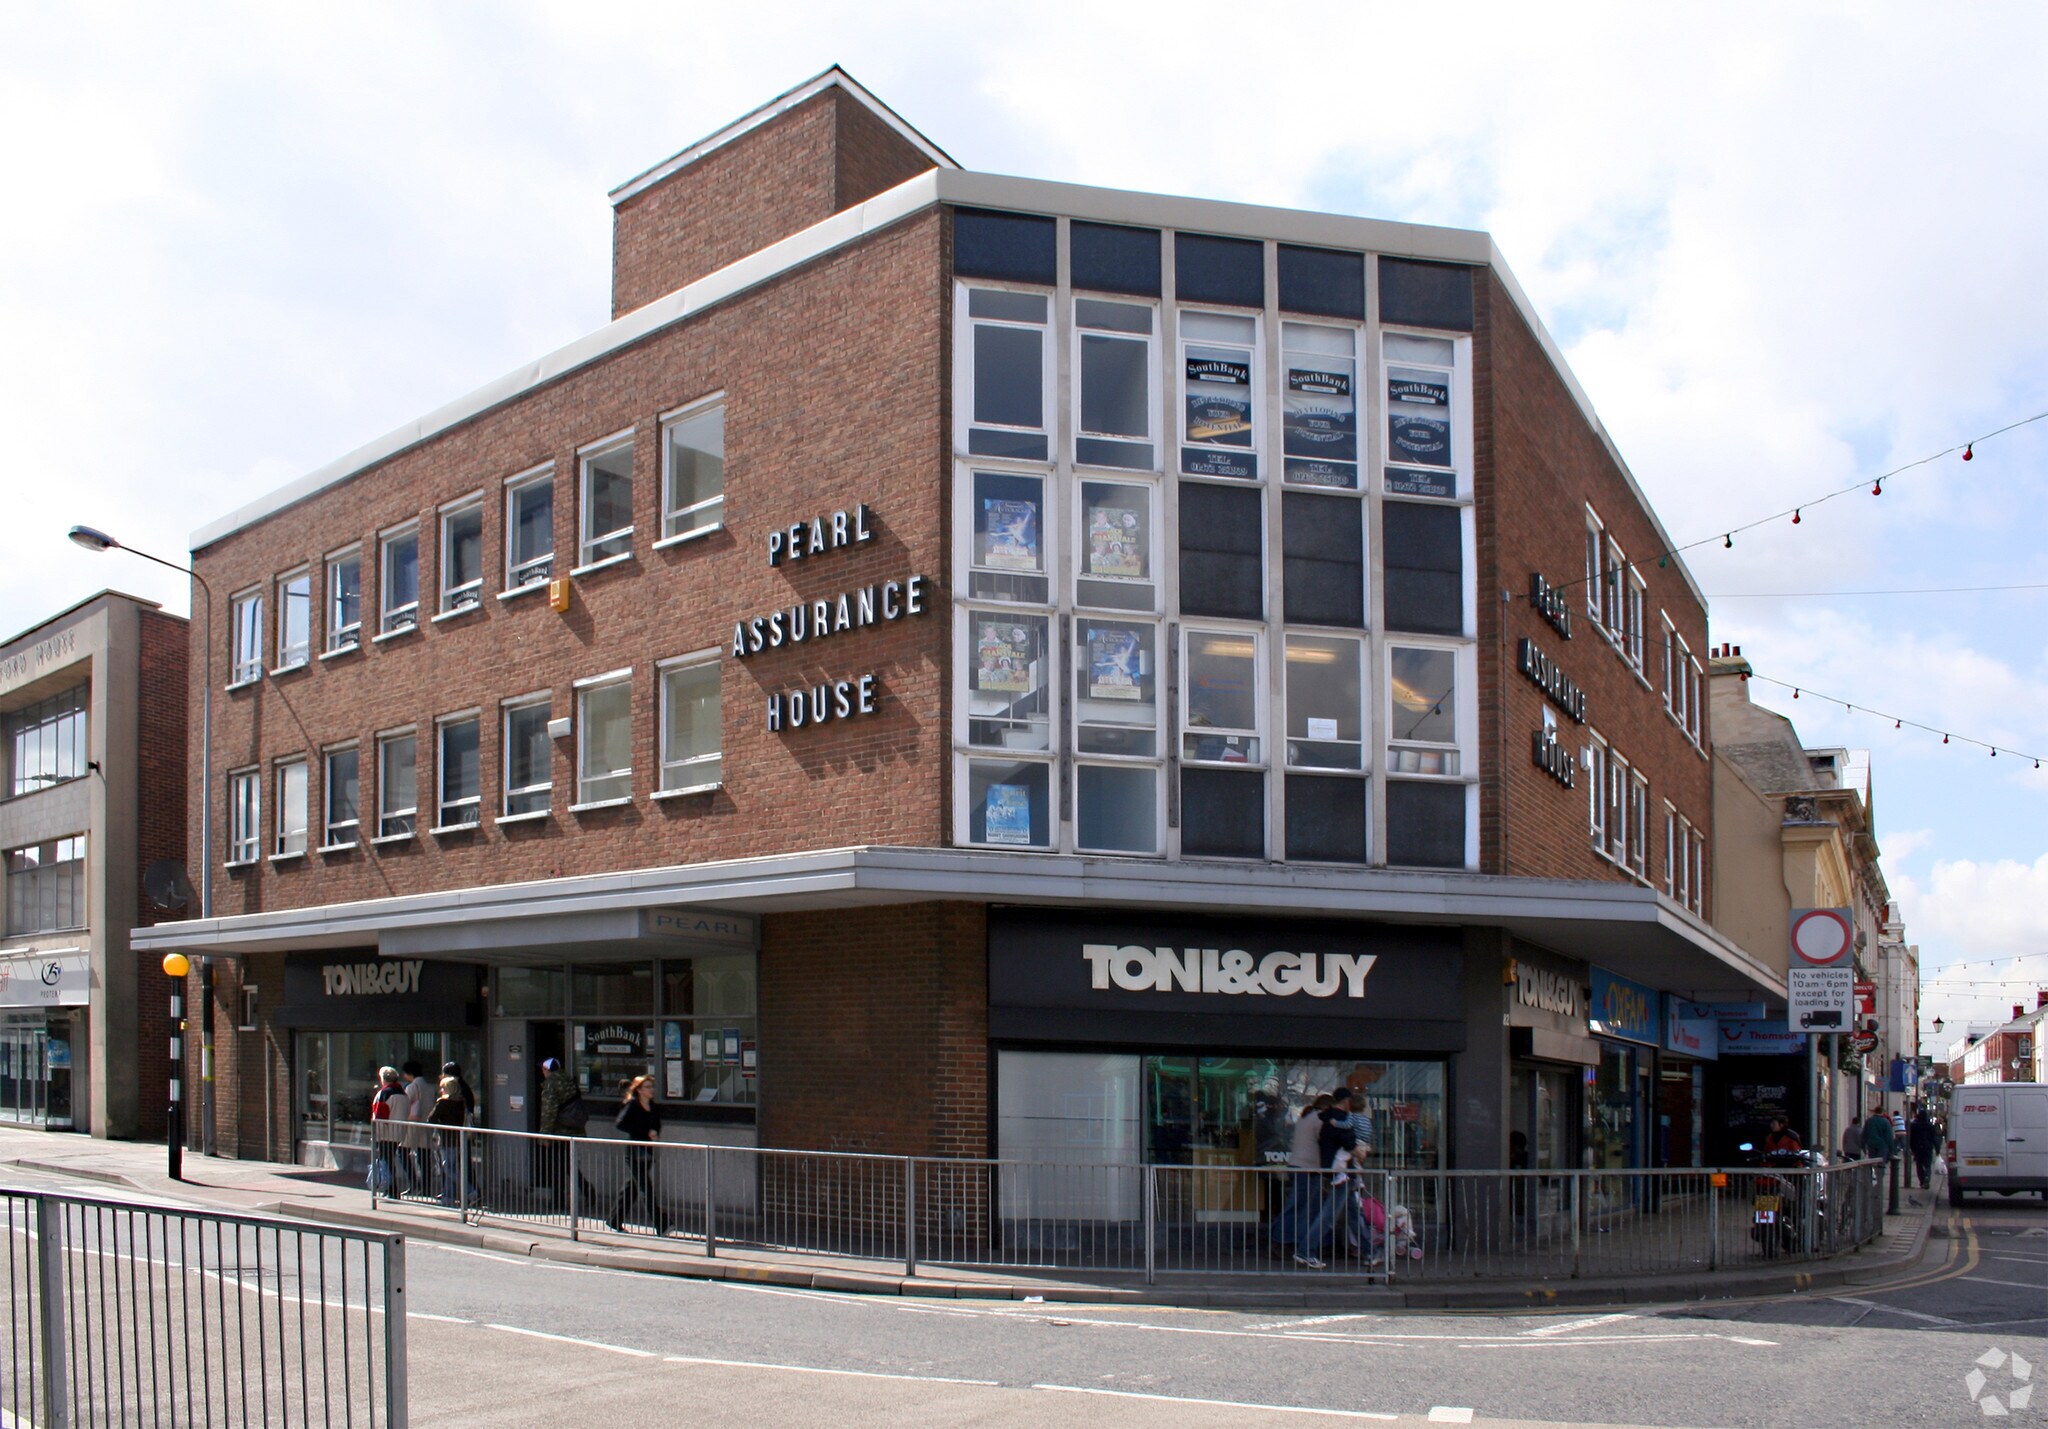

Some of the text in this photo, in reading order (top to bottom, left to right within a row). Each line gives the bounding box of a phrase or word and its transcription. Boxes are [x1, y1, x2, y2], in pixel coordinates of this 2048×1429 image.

[1188, 362, 1248, 380] SouthBank
[1290, 373, 1348, 391] SouthBank
[1390, 383, 1447, 402] SouthBank
[768, 503, 874, 568] PEARL
[732, 574, 931, 658] ASSURANCE
[1517, 637, 1585, 725] ASSURANCE
[767, 674, 880, 732] HOUSE
[1533, 730, 1575, 790] HOUSE
[656, 915, 747, 936] PEARL
[322, 959, 424, 996] TONI&GUY
[1082, 943, 1378, 999] TONI&GUY
[1792, 971, 1849, 979] No vehicles
[1516, 963, 1582, 1018] TONI&GUY
[1795, 990, 1828, 998] except
[1795, 999, 1845, 1007] loading by
[1606, 981, 1648, 1036] OXFAM
[587, 1025, 643, 1048] SouthBank
[1748, 1030, 1798, 1041] Thomson
